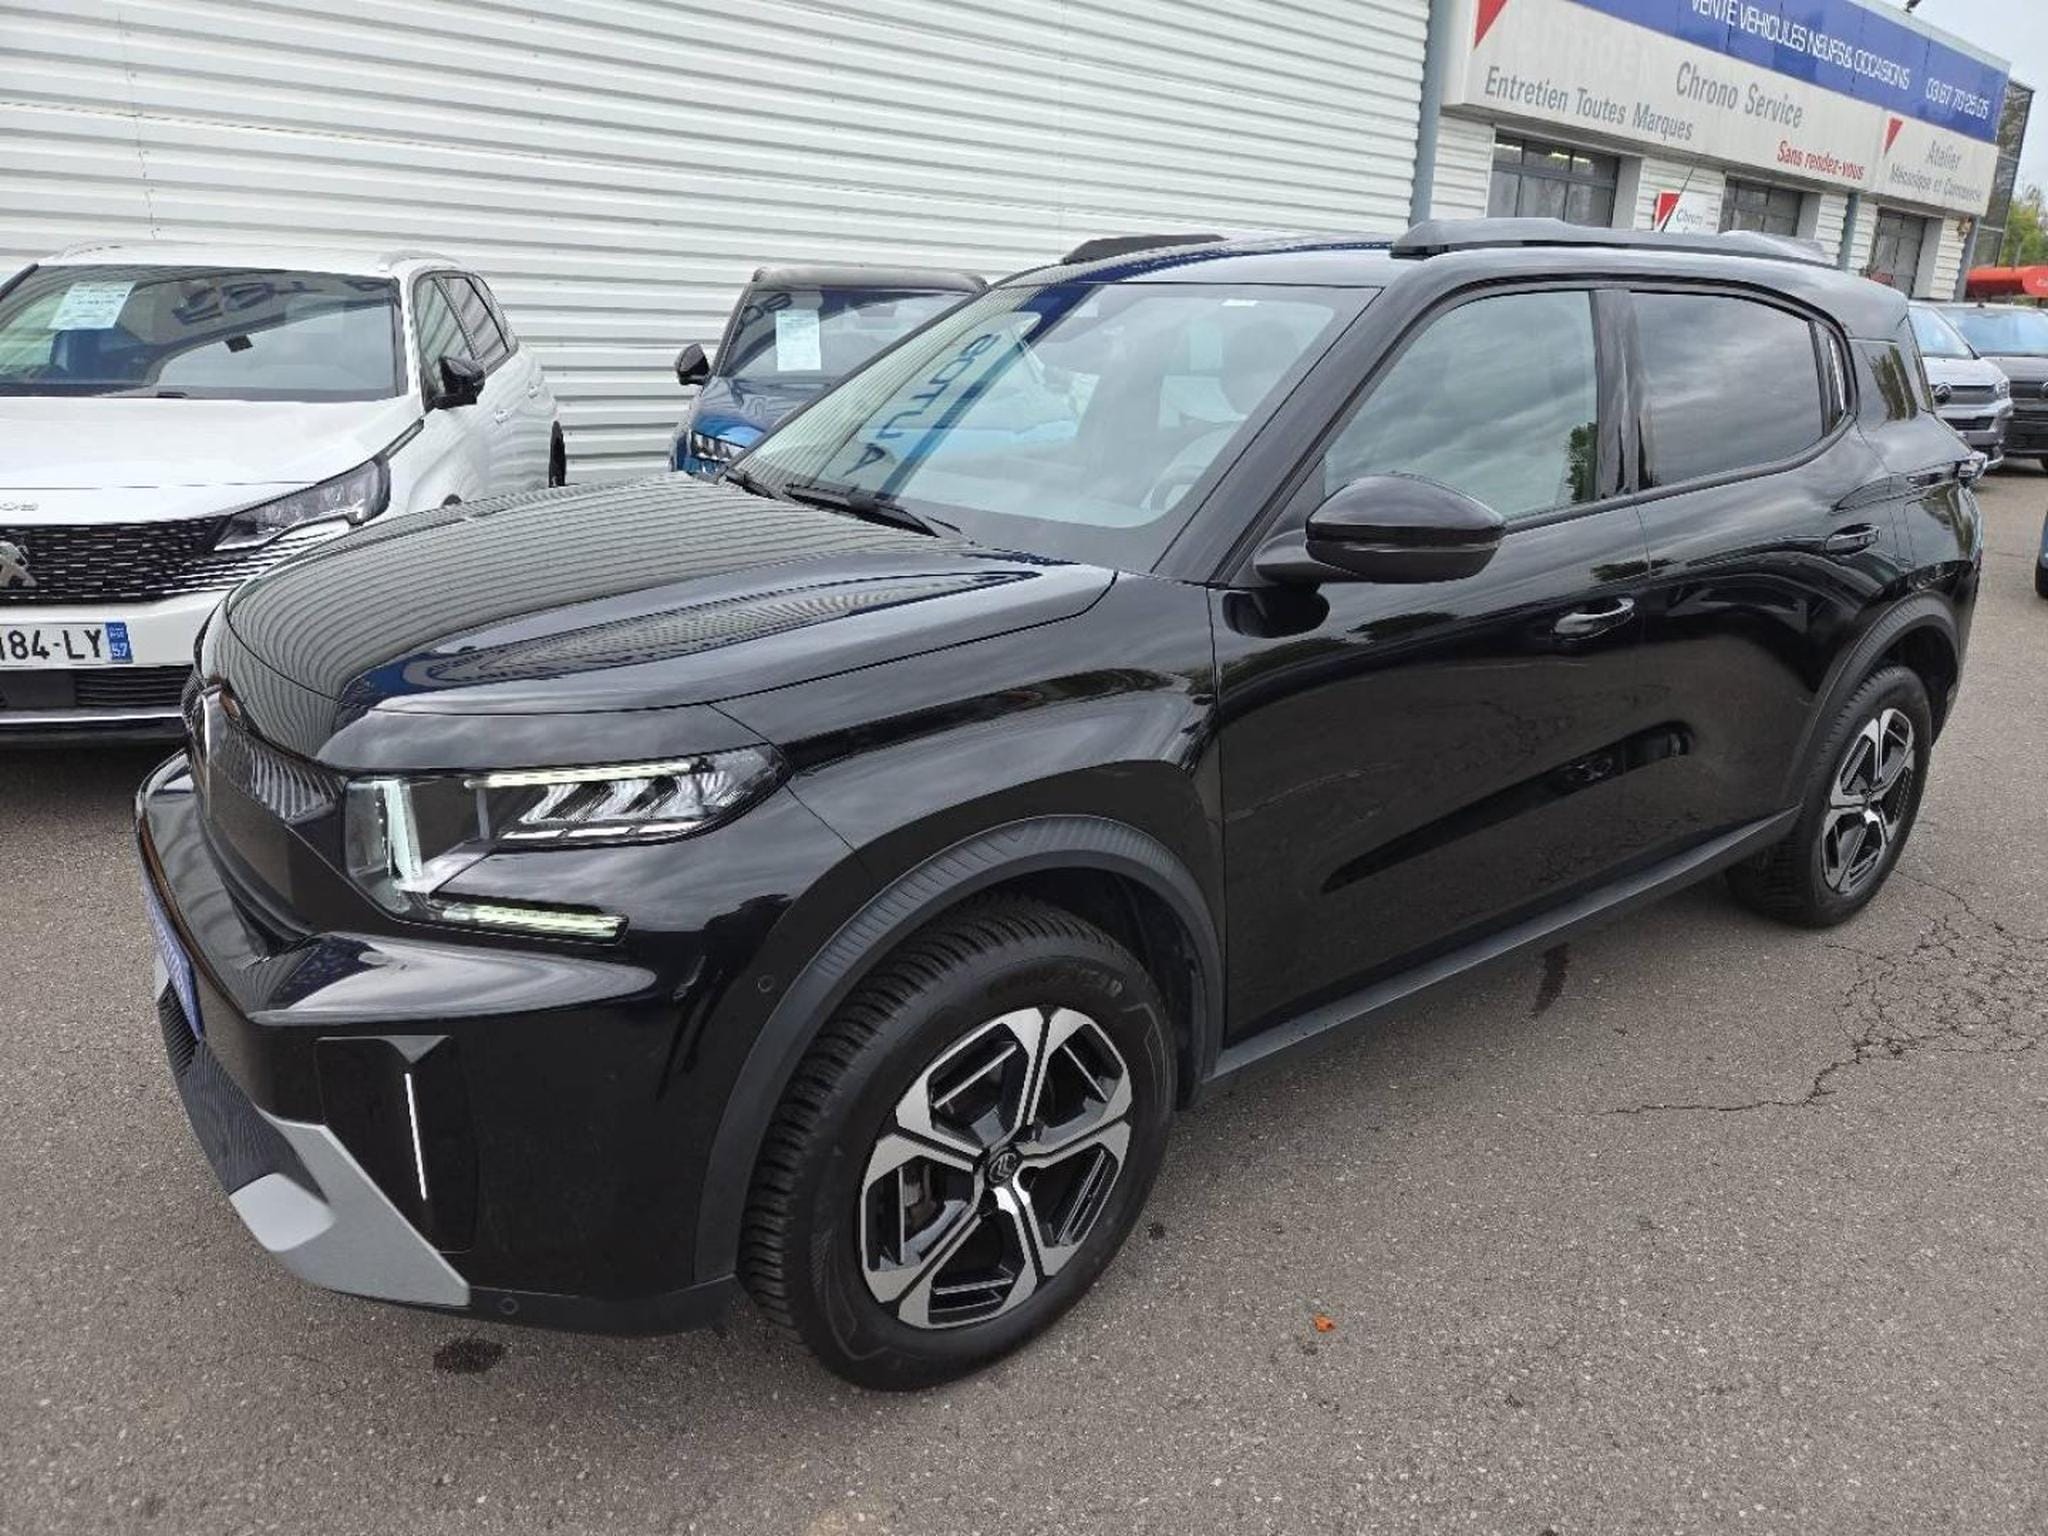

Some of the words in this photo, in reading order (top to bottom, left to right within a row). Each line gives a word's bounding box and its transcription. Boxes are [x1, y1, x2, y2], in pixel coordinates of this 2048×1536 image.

[1484, 65, 1569, 113] Entretien
[1575, 86, 1627, 125] Toutes
[1632, 101, 1694, 142] Marques
[1676, 60, 1739, 110] Chrono
[1745, 83, 1803, 129] Service
[1776, 139, 1803, 167] Sans
[1803, 153, 1865, 181] rendez-vous
[111, 641, 128, 657] 57
